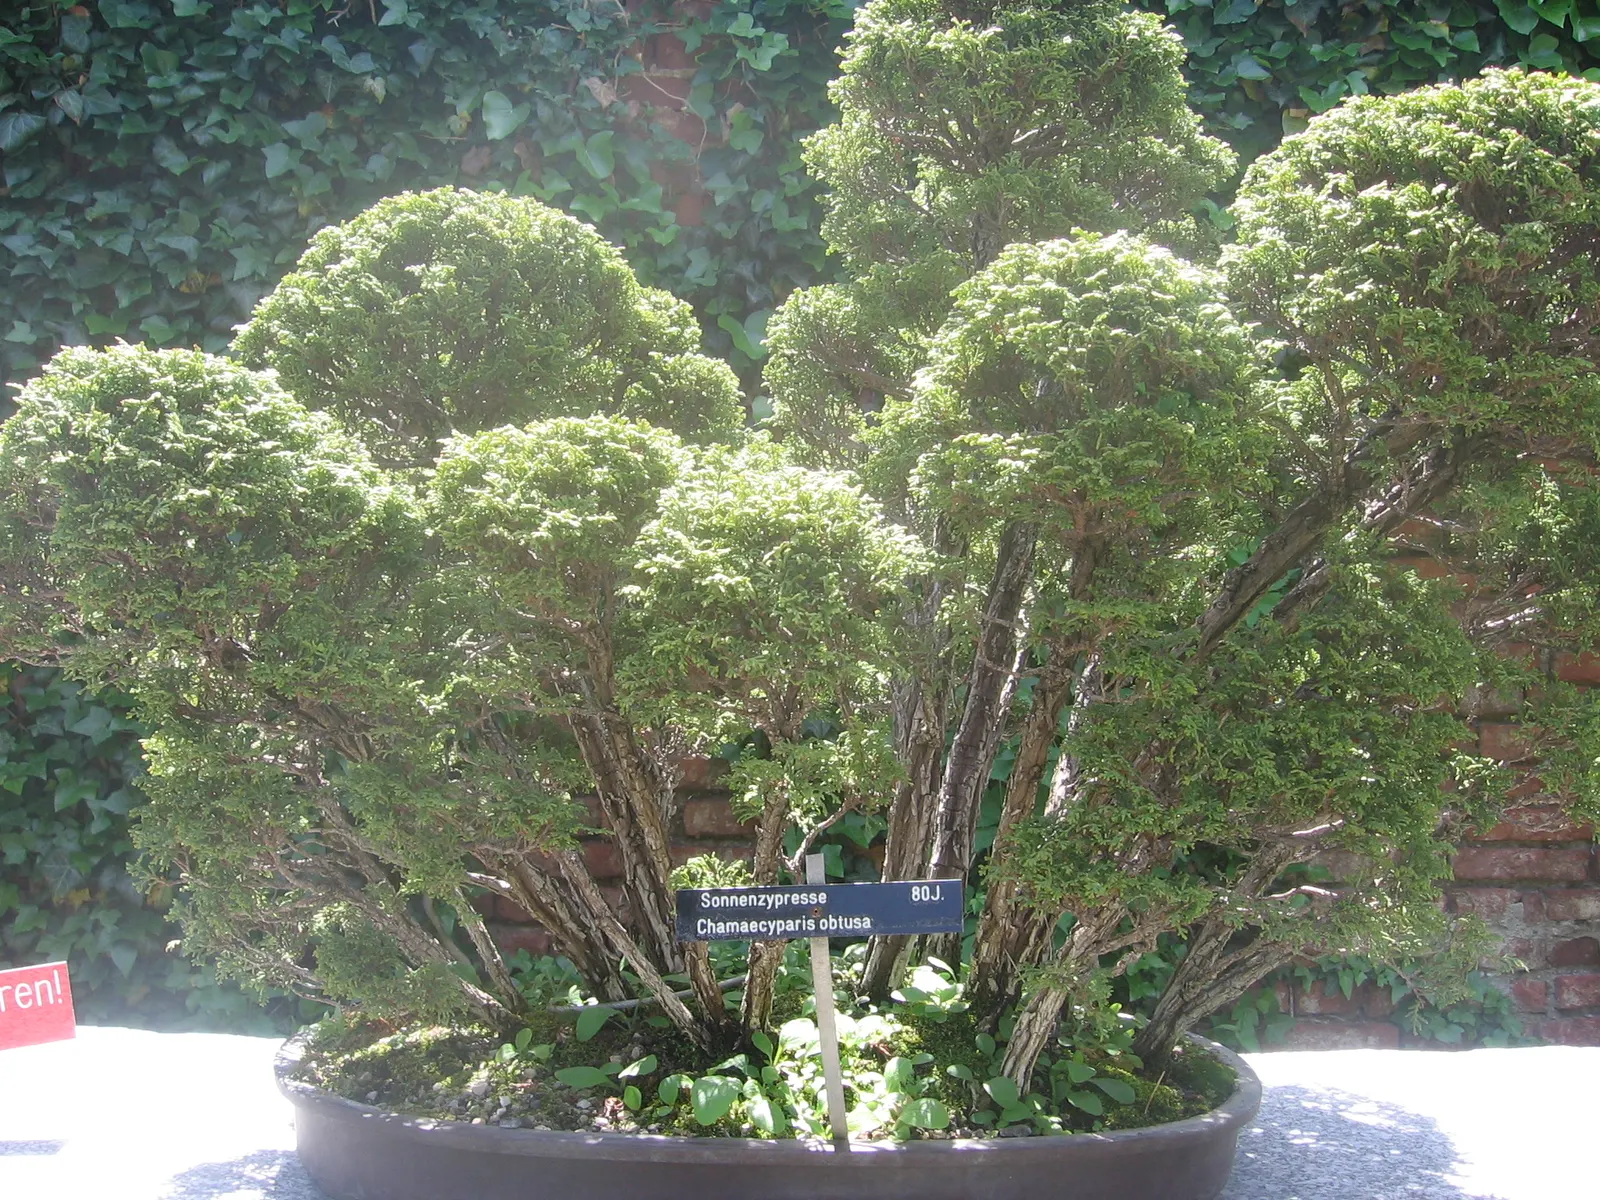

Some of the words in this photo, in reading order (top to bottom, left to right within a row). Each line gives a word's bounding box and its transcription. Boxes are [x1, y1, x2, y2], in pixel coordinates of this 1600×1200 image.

[701, 892, 827, 909] Sonnenzypresse
[911, 885, 944, 901] 80J.
[697, 915, 815, 935] Chamaecyparis
[819, 914, 872, 930] obtusa
